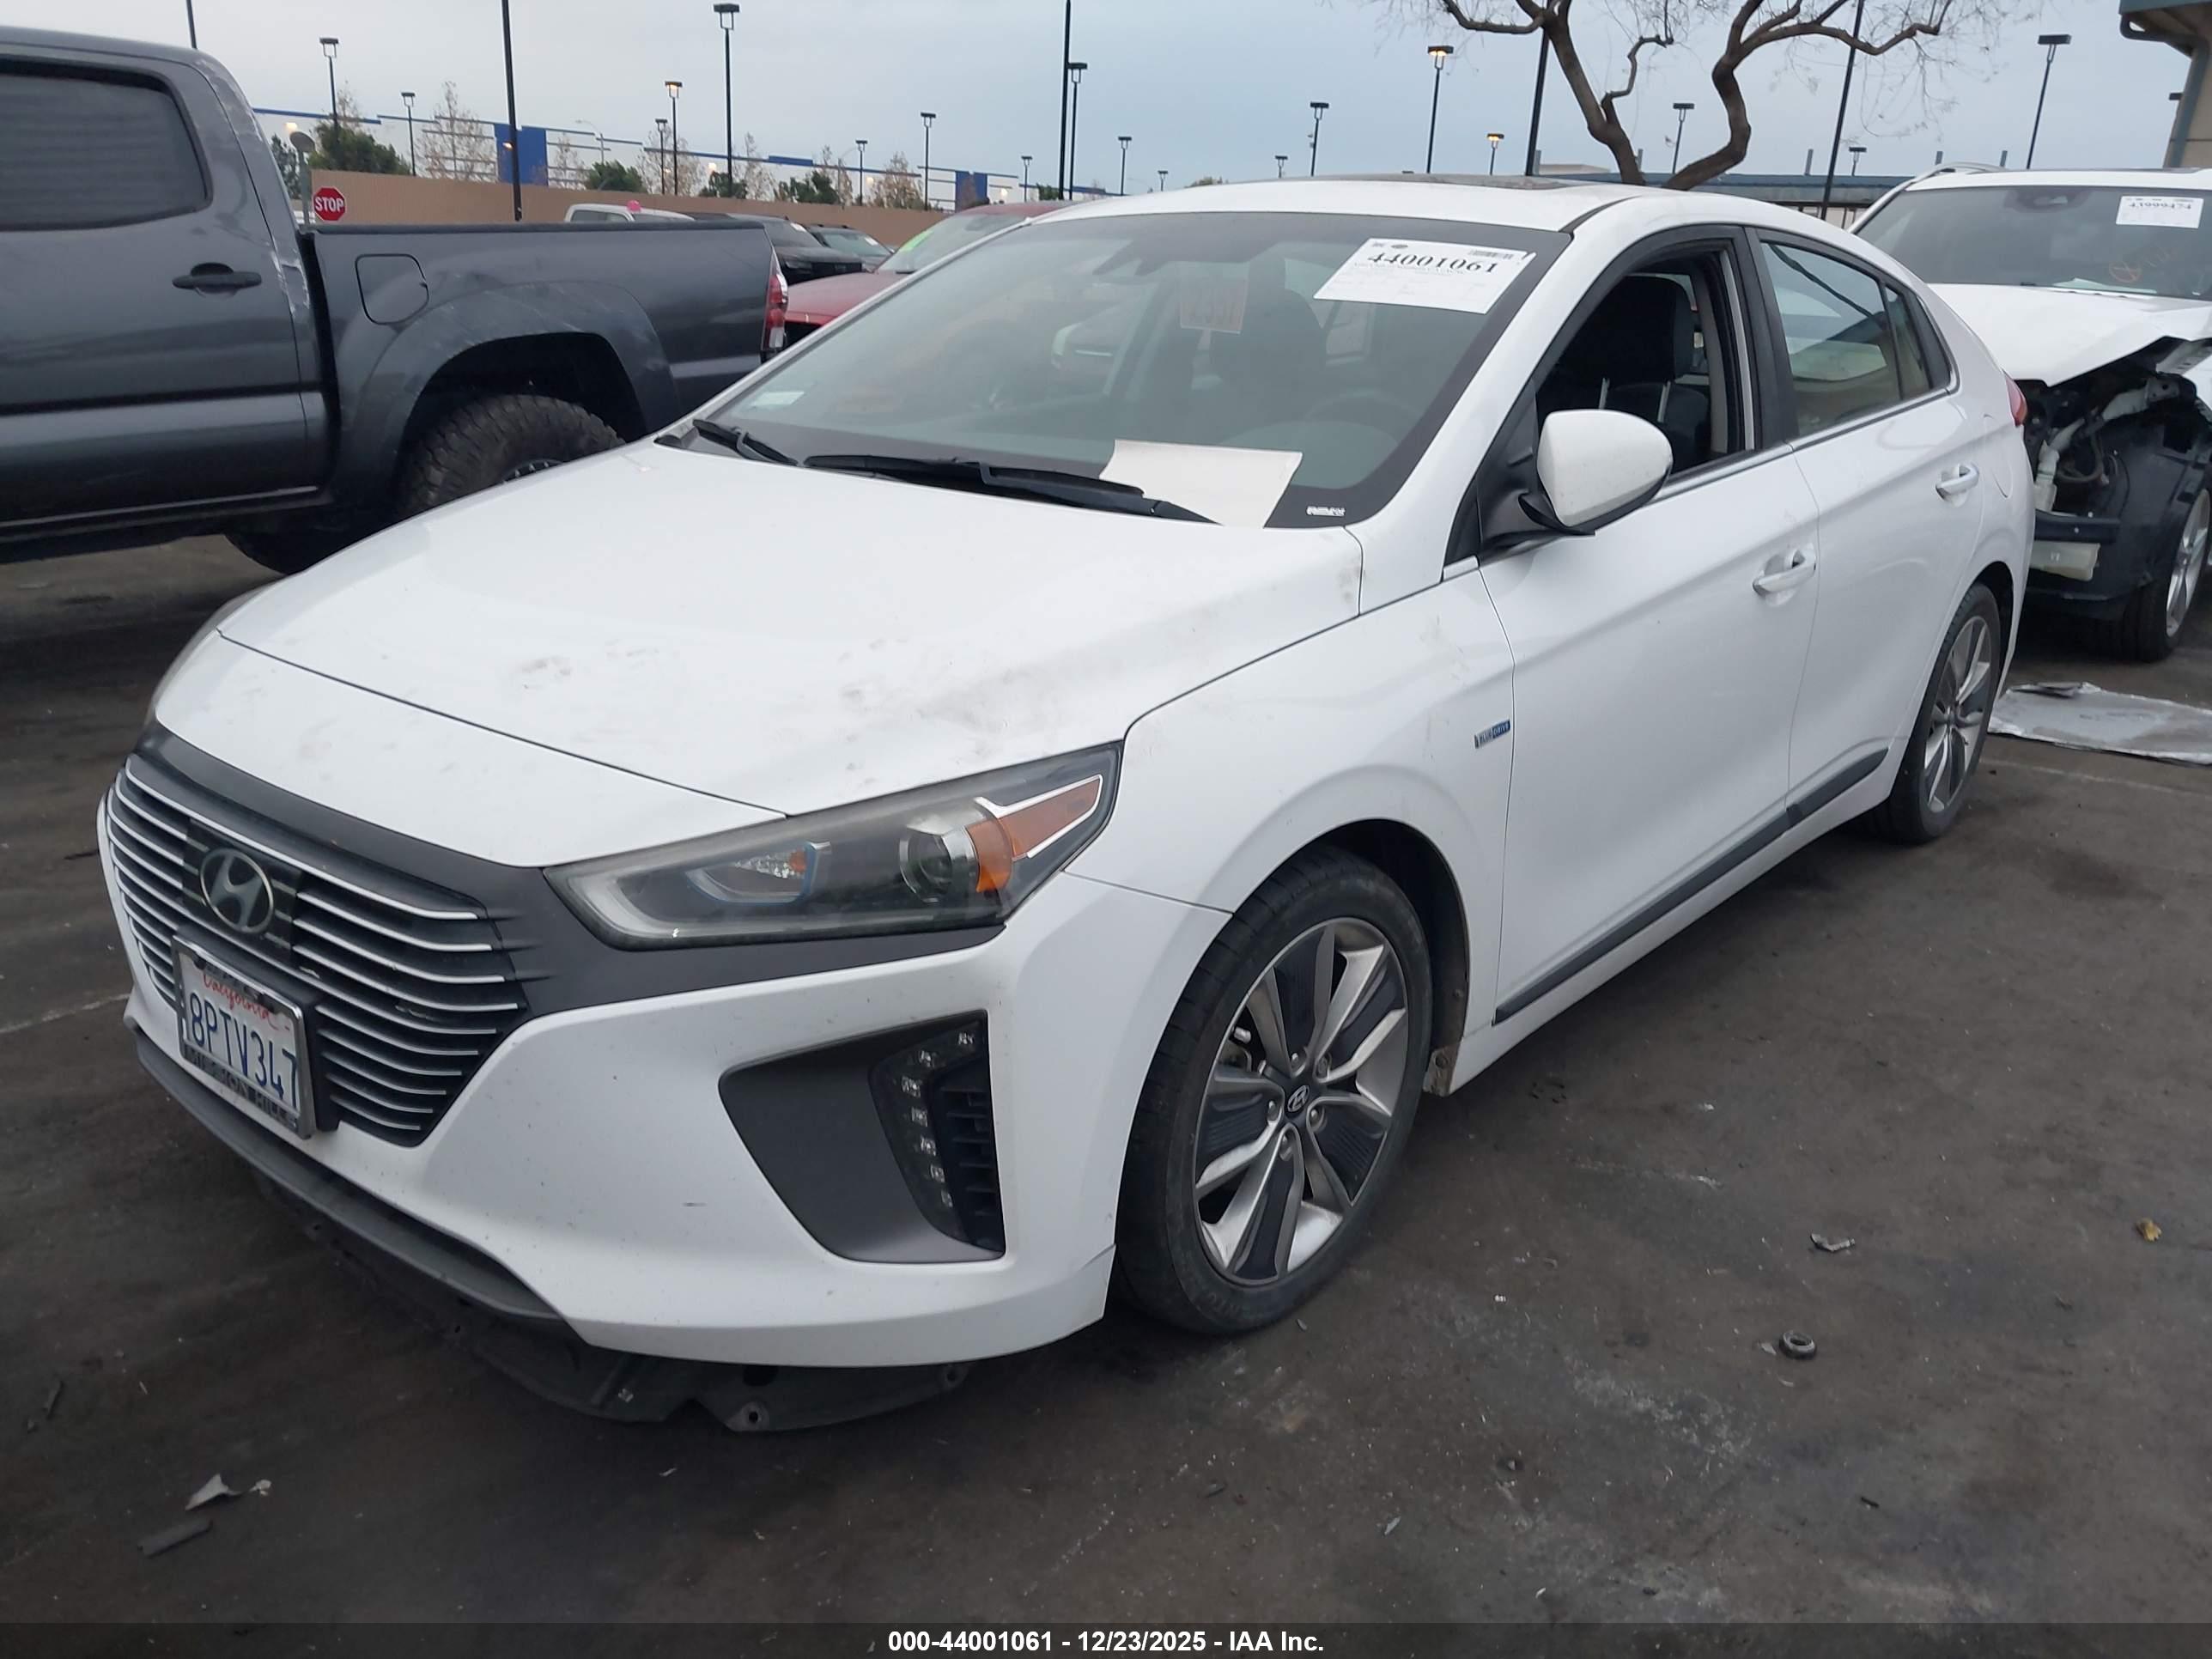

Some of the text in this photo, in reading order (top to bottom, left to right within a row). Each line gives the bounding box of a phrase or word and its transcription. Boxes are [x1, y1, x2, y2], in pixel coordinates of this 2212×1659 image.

[315, 197, 343, 212] STOP
[1366, 251, 1499, 274] 44001061
[189, 991, 299, 1115] 8PTV347
